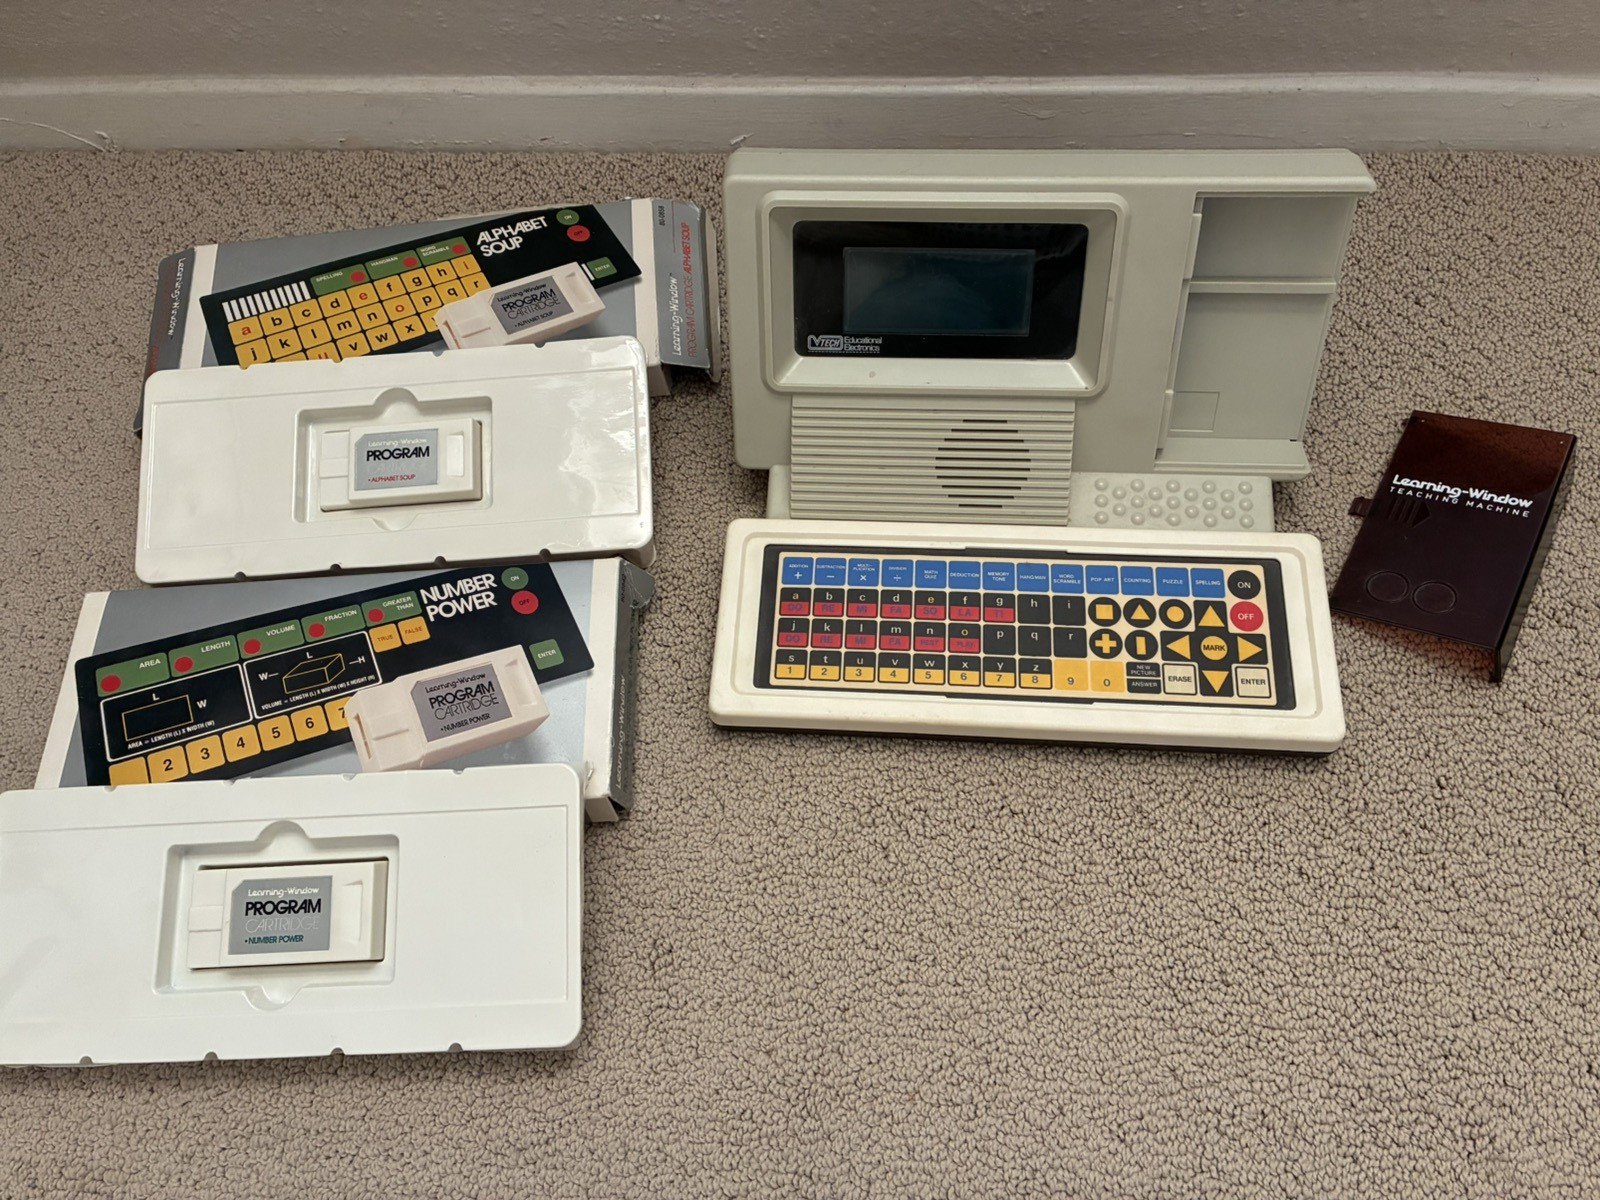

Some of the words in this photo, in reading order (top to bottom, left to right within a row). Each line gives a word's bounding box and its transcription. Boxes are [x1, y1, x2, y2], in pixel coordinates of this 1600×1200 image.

[476, 216, 548, 246] ALPHABET
[681, 222, 691, 241] SOUP
[480, 236, 524, 257] SOUP
[371, 256, 399, 267] HANGMAN
[681, 241, 692, 275] ALPHABET
[463, 261, 469, 270] i
[594, 263, 611, 272] ENTER
[316, 271, 343, 282] SPELLING
[436, 267, 448, 277] h
[412, 276, 422, 286] g
[473, 280, 480, 288] r
[386, 282, 393, 292] f
[447, 287, 459, 297] q
[359, 291, 368, 300] e
[422, 295, 432, 306] p
[502, 288, 556, 312] PROGRAM
[684, 275, 695, 316] CARTRIDGE
[330, 298, 340, 309] d
[395, 304, 405, 313] o
[507, 297, 561, 319] CARTRIDGE
[302, 309, 311, 318] c
[367, 311, 378, 321] n
[271, 317, 283, 327] b
[517, 315, 540, 327] ALPHABET
[540, 311, 554, 319] SOUP
[337, 319, 352, 331] m
[405, 324, 415, 333] x
[241, 326, 251, 335] a
[375, 332, 388, 343] w
[686, 317, 697, 358] PROGRAM
[844, 336, 883, 344] Educational
[279, 338, 291, 349] k
[348, 342, 358, 351] v
[844, 343, 880, 351] Electronics
[250, 347, 257, 361] j
[366, 446, 430, 461] PROGRAM
[371, 475, 399, 483] ALPHABET
[1392, 474, 1533, 508] Learning-Window
[1389, 486, 1459, 505] TEACHING
[1465, 500, 1531, 518] MACHINE
[419, 573, 498, 605] NUMBER
[1237, 581, 1251, 589] ON
[792, 592, 799, 600] a
[826, 591, 833, 600] b
[893, 593, 900, 602] d
[927, 596, 935, 604] e
[963, 596, 968, 605] f
[382, 596, 412, 608] GREATER
[396, 602, 414, 611] THAN
[425, 591, 498, 622] POWER
[518, 598, 531, 606] OFF
[996, 597, 1004, 607] g
[1030, 598, 1038, 608] h
[1067, 600, 1071, 609] i
[324, 609, 358, 622] FRACTION
[265, 624, 296, 637] VOLUME
[404, 626, 423, 636] FALSE
[791, 621, 796, 631] j
[824, 622, 831, 632] k
[891, 626, 902, 634] m
[926, 627, 934, 635] n
[961, 628, 969, 636] o
[996, 630, 1004, 640] p
[1030, 630, 1039, 641] q
[1068, 632, 1074, 641] r
[376, 634, 393, 643] TRUE
[200, 640, 231, 653] LENGTH
[1202, 644, 1226, 652] MARK
[537, 649, 557, 659] ENTER
[788, 654, 795, 662] s
[139, 658, 161, 669] AREA
[358, 655, 366, 664] H
[823, 655, 829, 664] t
[857, 657, 864, 665] u
[924, 659, 935, 667] w
[787, 666, 792, 674] 1
[961, 661, 969, 669] x
[996, 661, 1004, 671] y
[1033, 663, 1039, 671] z
[258, 672, 268, 681] W
[821, 667, 828, 676] 2
[855, 668, 862, 677] 3
[890, 669, 897, 678] 4
[925, 670, 932, 679] 5
[960, 672, 968, 681] 6
[996, 673, 1003, 682] 7
[1032, 675, 1039, 684] 8
[1067, 676, 1075, 686] 9
[1167, 675, 1193, 683] ERASE
[1240, 678, 1266, 686] ENTER
[152, 693, 160, 701] L
[261, 700, 282, 710] VOLUME
[289, 692, 309, 703] LENGTH
[321, 685, 338, 694] WIDTH
[350, 676, 367, 686] HEIGHT
[429, 681, 495, 709] PROGRAM
[196, 699, 208, 709] W
[434, 693, 499, 720] CARTRIDGE
[305, 717, 314, 729] 6
[443, 719, 469, 732] NUMBER
[469, 713, 491, 725] POWER
[127, 740, 143, 750] AREA
[151, 732, 173, 743] LENGTH
[186, 722, 204, 733] WIDTH
[271, 726, 281, 739] 5
[235, 737, 246, 749] 4
[200, 748, 210, 760] 3
[163, 759, 174, 771] 2
[248, 886, 320, 898] Learning-Window
[245, 898, 322, 916] PROGRAM
[245, 915, 320, 933] CARTRIDGE
[248, 936, 277, 944] NUMBER
[278, 934, 304, 943] POWER
